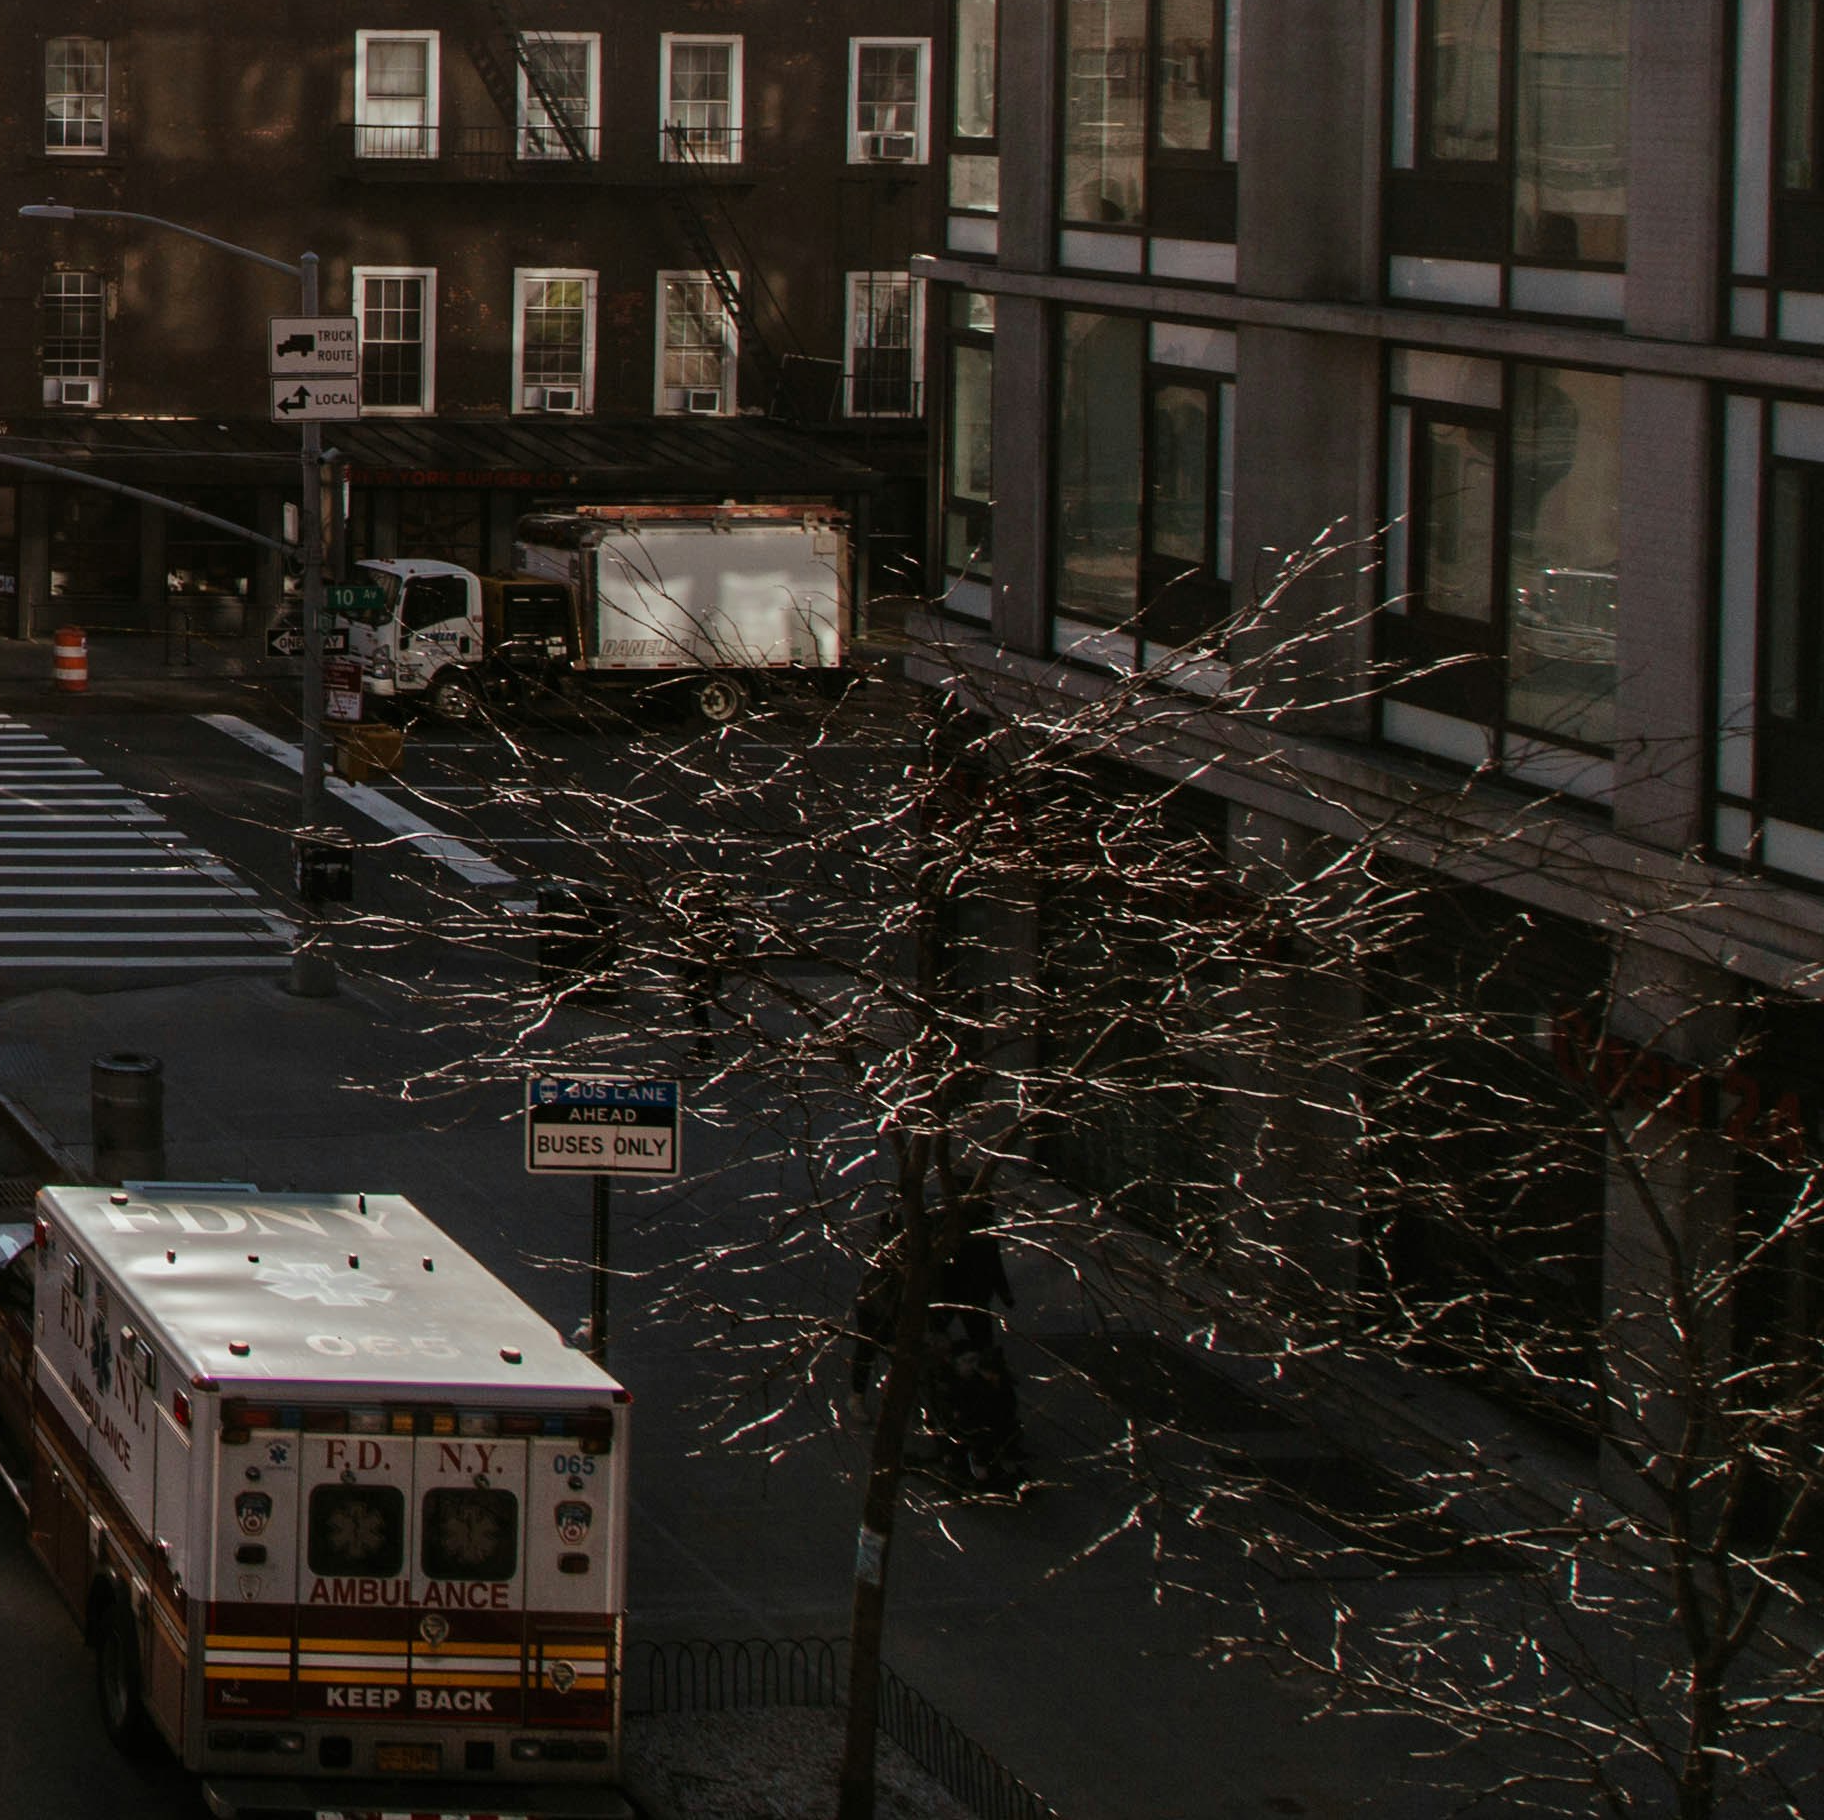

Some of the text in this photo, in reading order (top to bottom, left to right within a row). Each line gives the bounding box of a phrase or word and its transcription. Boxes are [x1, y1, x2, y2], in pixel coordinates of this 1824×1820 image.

[317, 330, 353, 341] TRUCK
[317, 350, 353, 361] ROUTE
[315, 393, 356, 405] LOCAL
[334, 589, 377, 606] 10 Av
[601, 638, 690, 657] DANELLA
[568, 1084, 668, 1102] BUS LANE
[568, 1107, 637, 1123] AHEAD
[537, 1135, 668, 1157] BUSES ONLY
[98, 1205, 395, 1237] FDNY
[71, 1371, 131, 1474] AMBULANCE
[325, 1439, 391, 1471] F.D.
[438, 1442, 503, 1474] N.Y.
[553, 1453, 596, 1475] 065
[309, 1577, 510, 1609] AMBULANCE
[326, 1686, 494, 1713] KEEP BACK
